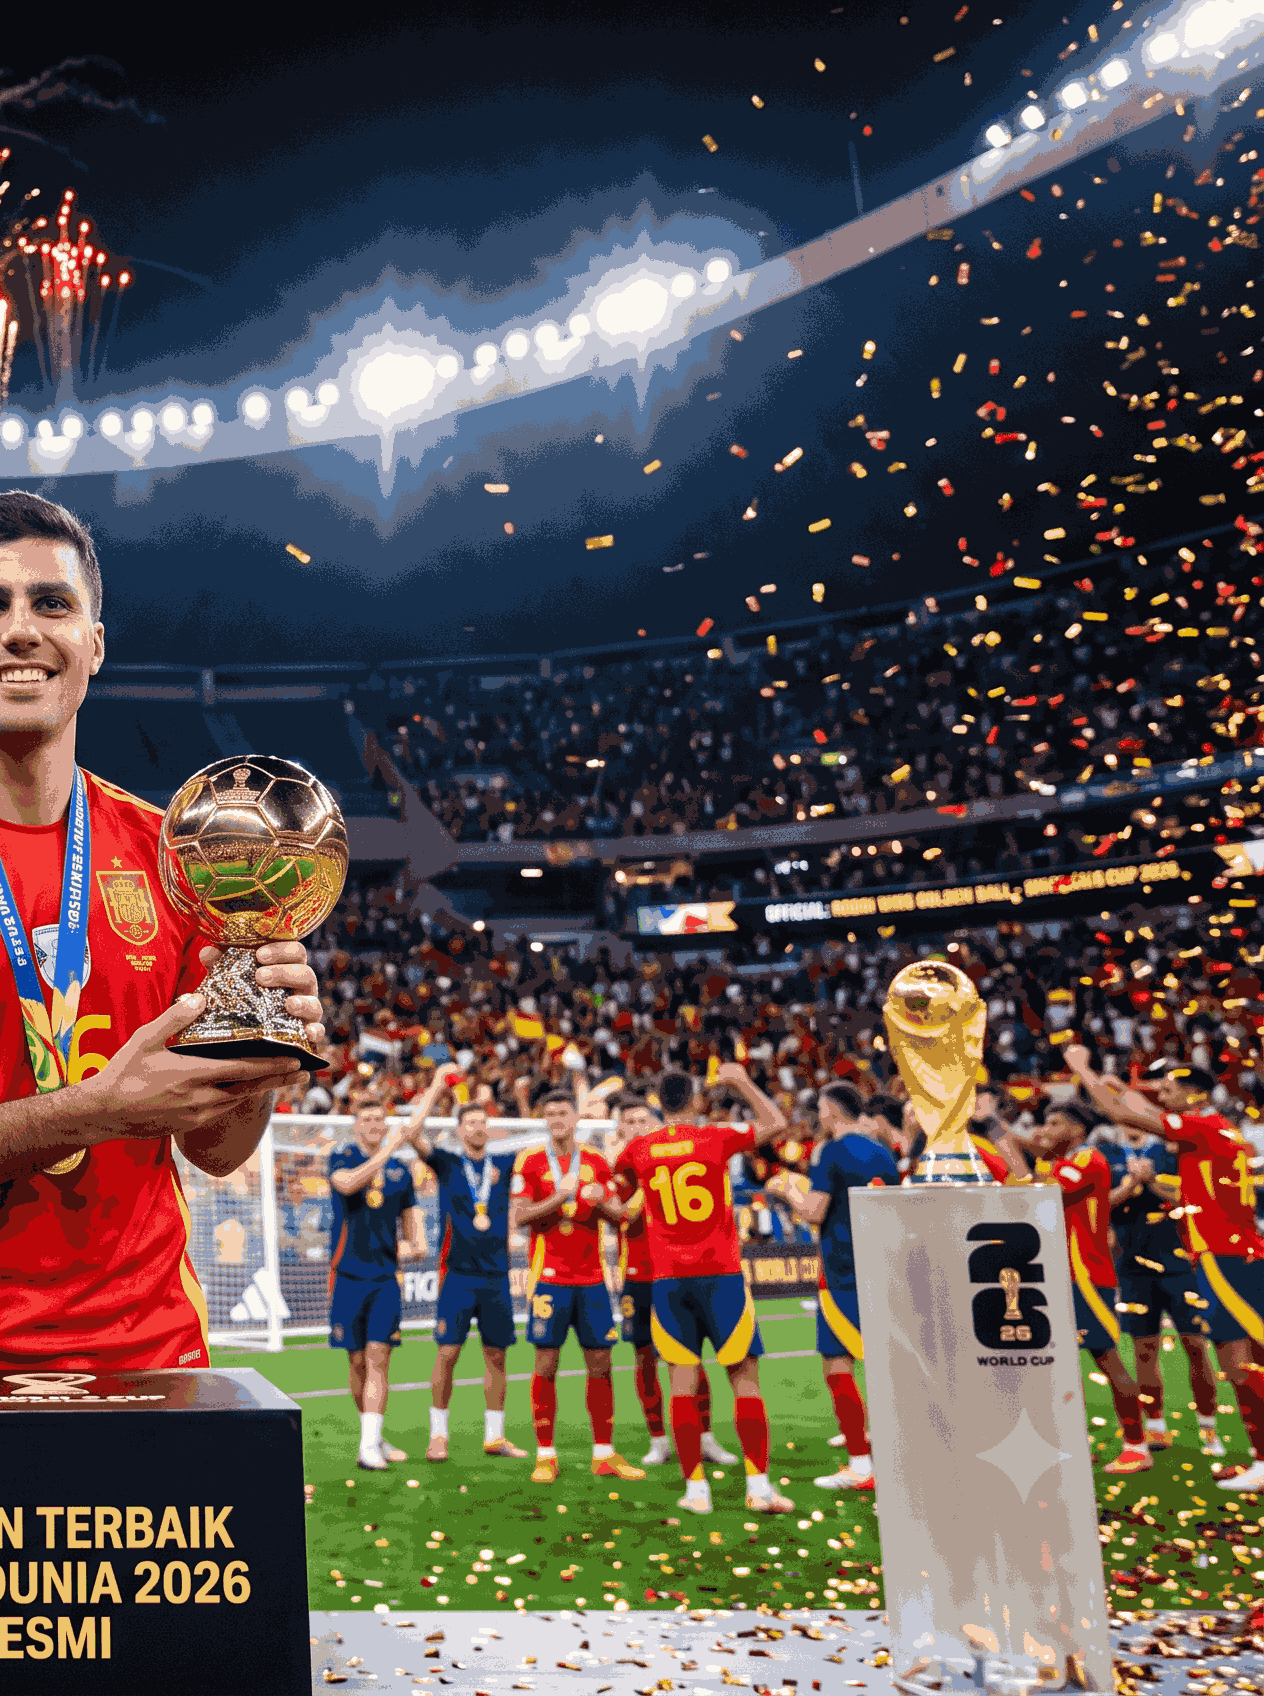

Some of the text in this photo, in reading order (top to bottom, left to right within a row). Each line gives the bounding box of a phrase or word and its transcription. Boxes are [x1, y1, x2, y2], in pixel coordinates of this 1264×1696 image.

[649, 1162, 714, 1225] 16
[977, 1356, 1055, 1367] WORLD CUP
[36, 1505, 235, 1549] TERBAIK
[133, 1560, 251, 1604] 2026
